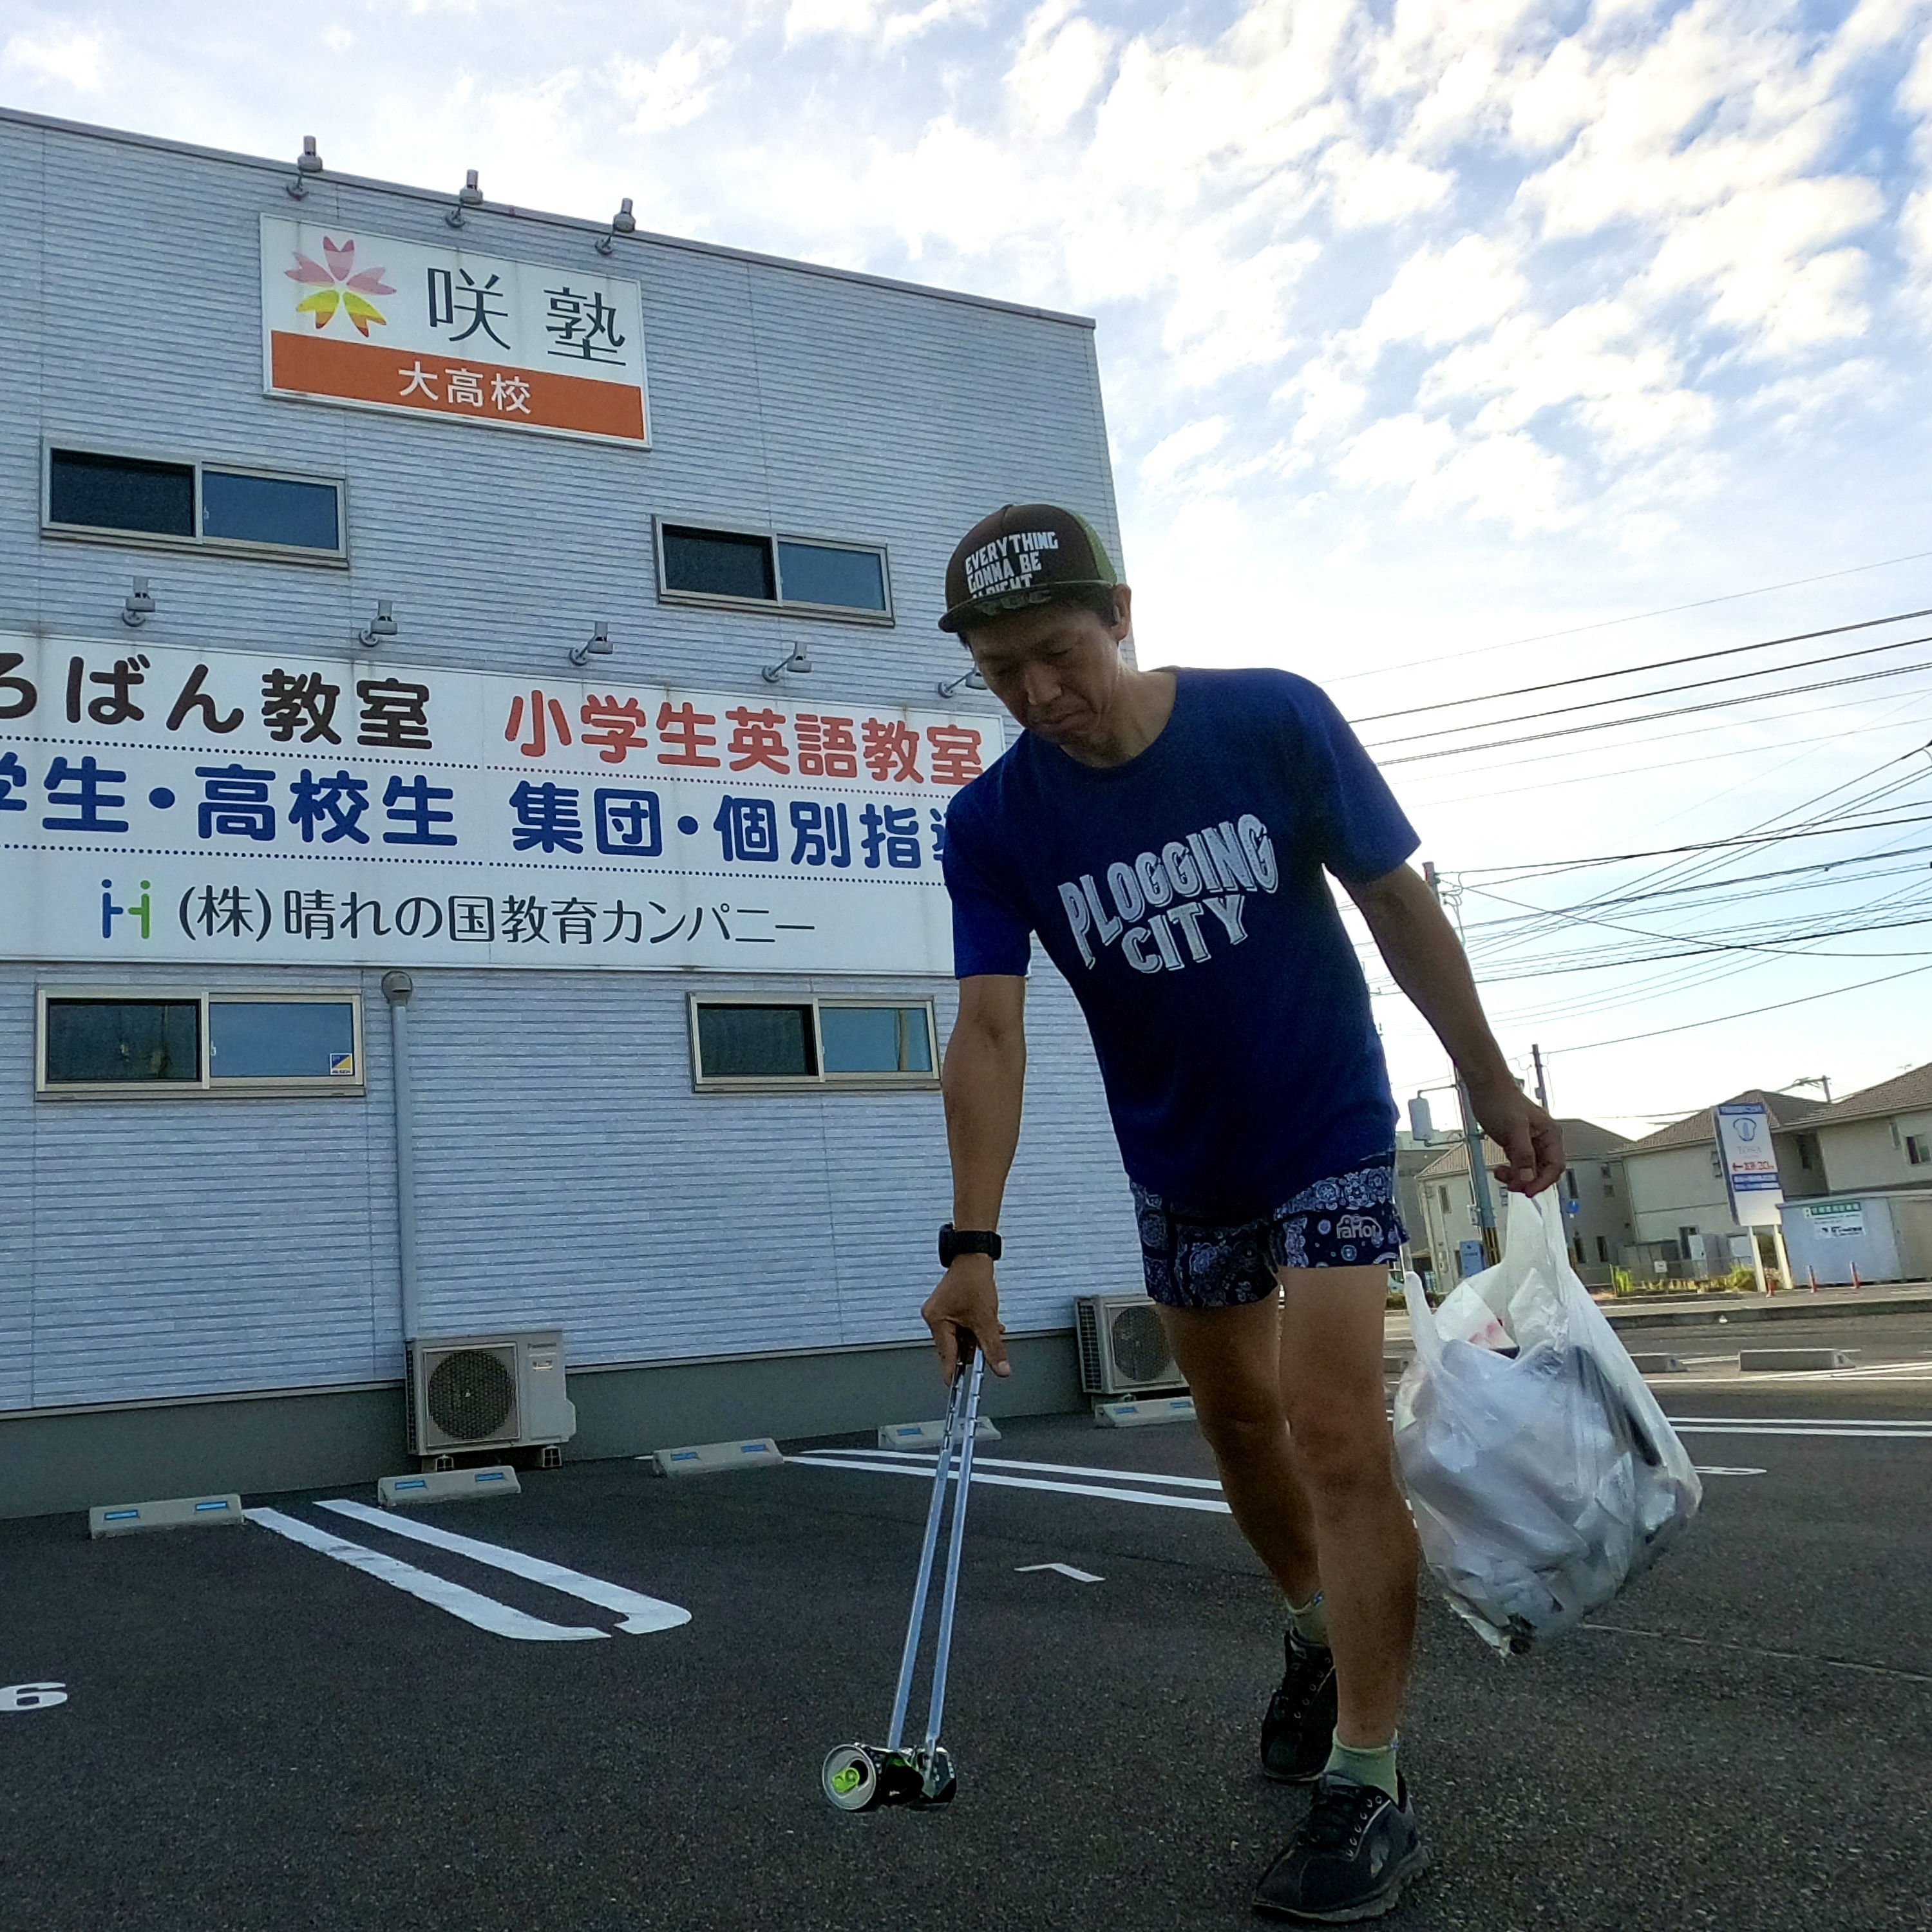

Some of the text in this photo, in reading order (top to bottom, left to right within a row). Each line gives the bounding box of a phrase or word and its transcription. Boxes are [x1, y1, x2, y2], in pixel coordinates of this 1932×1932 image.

[397, 361, 532, 415] 大高校
[965, 531, 1059, 575] EVERYTHING
[967, 551, 1042, 594] GONNA BE
[504, 690, 983, 786] 小学生英語教室
[509, 780, 947, 870] 集団・個別指
[178, 884, 815, 945] (株)晴れの国教育カンパニー
[1057, 813, 1278, 971] PLOGGING
[1121, 894, 1249, 974] CITY
